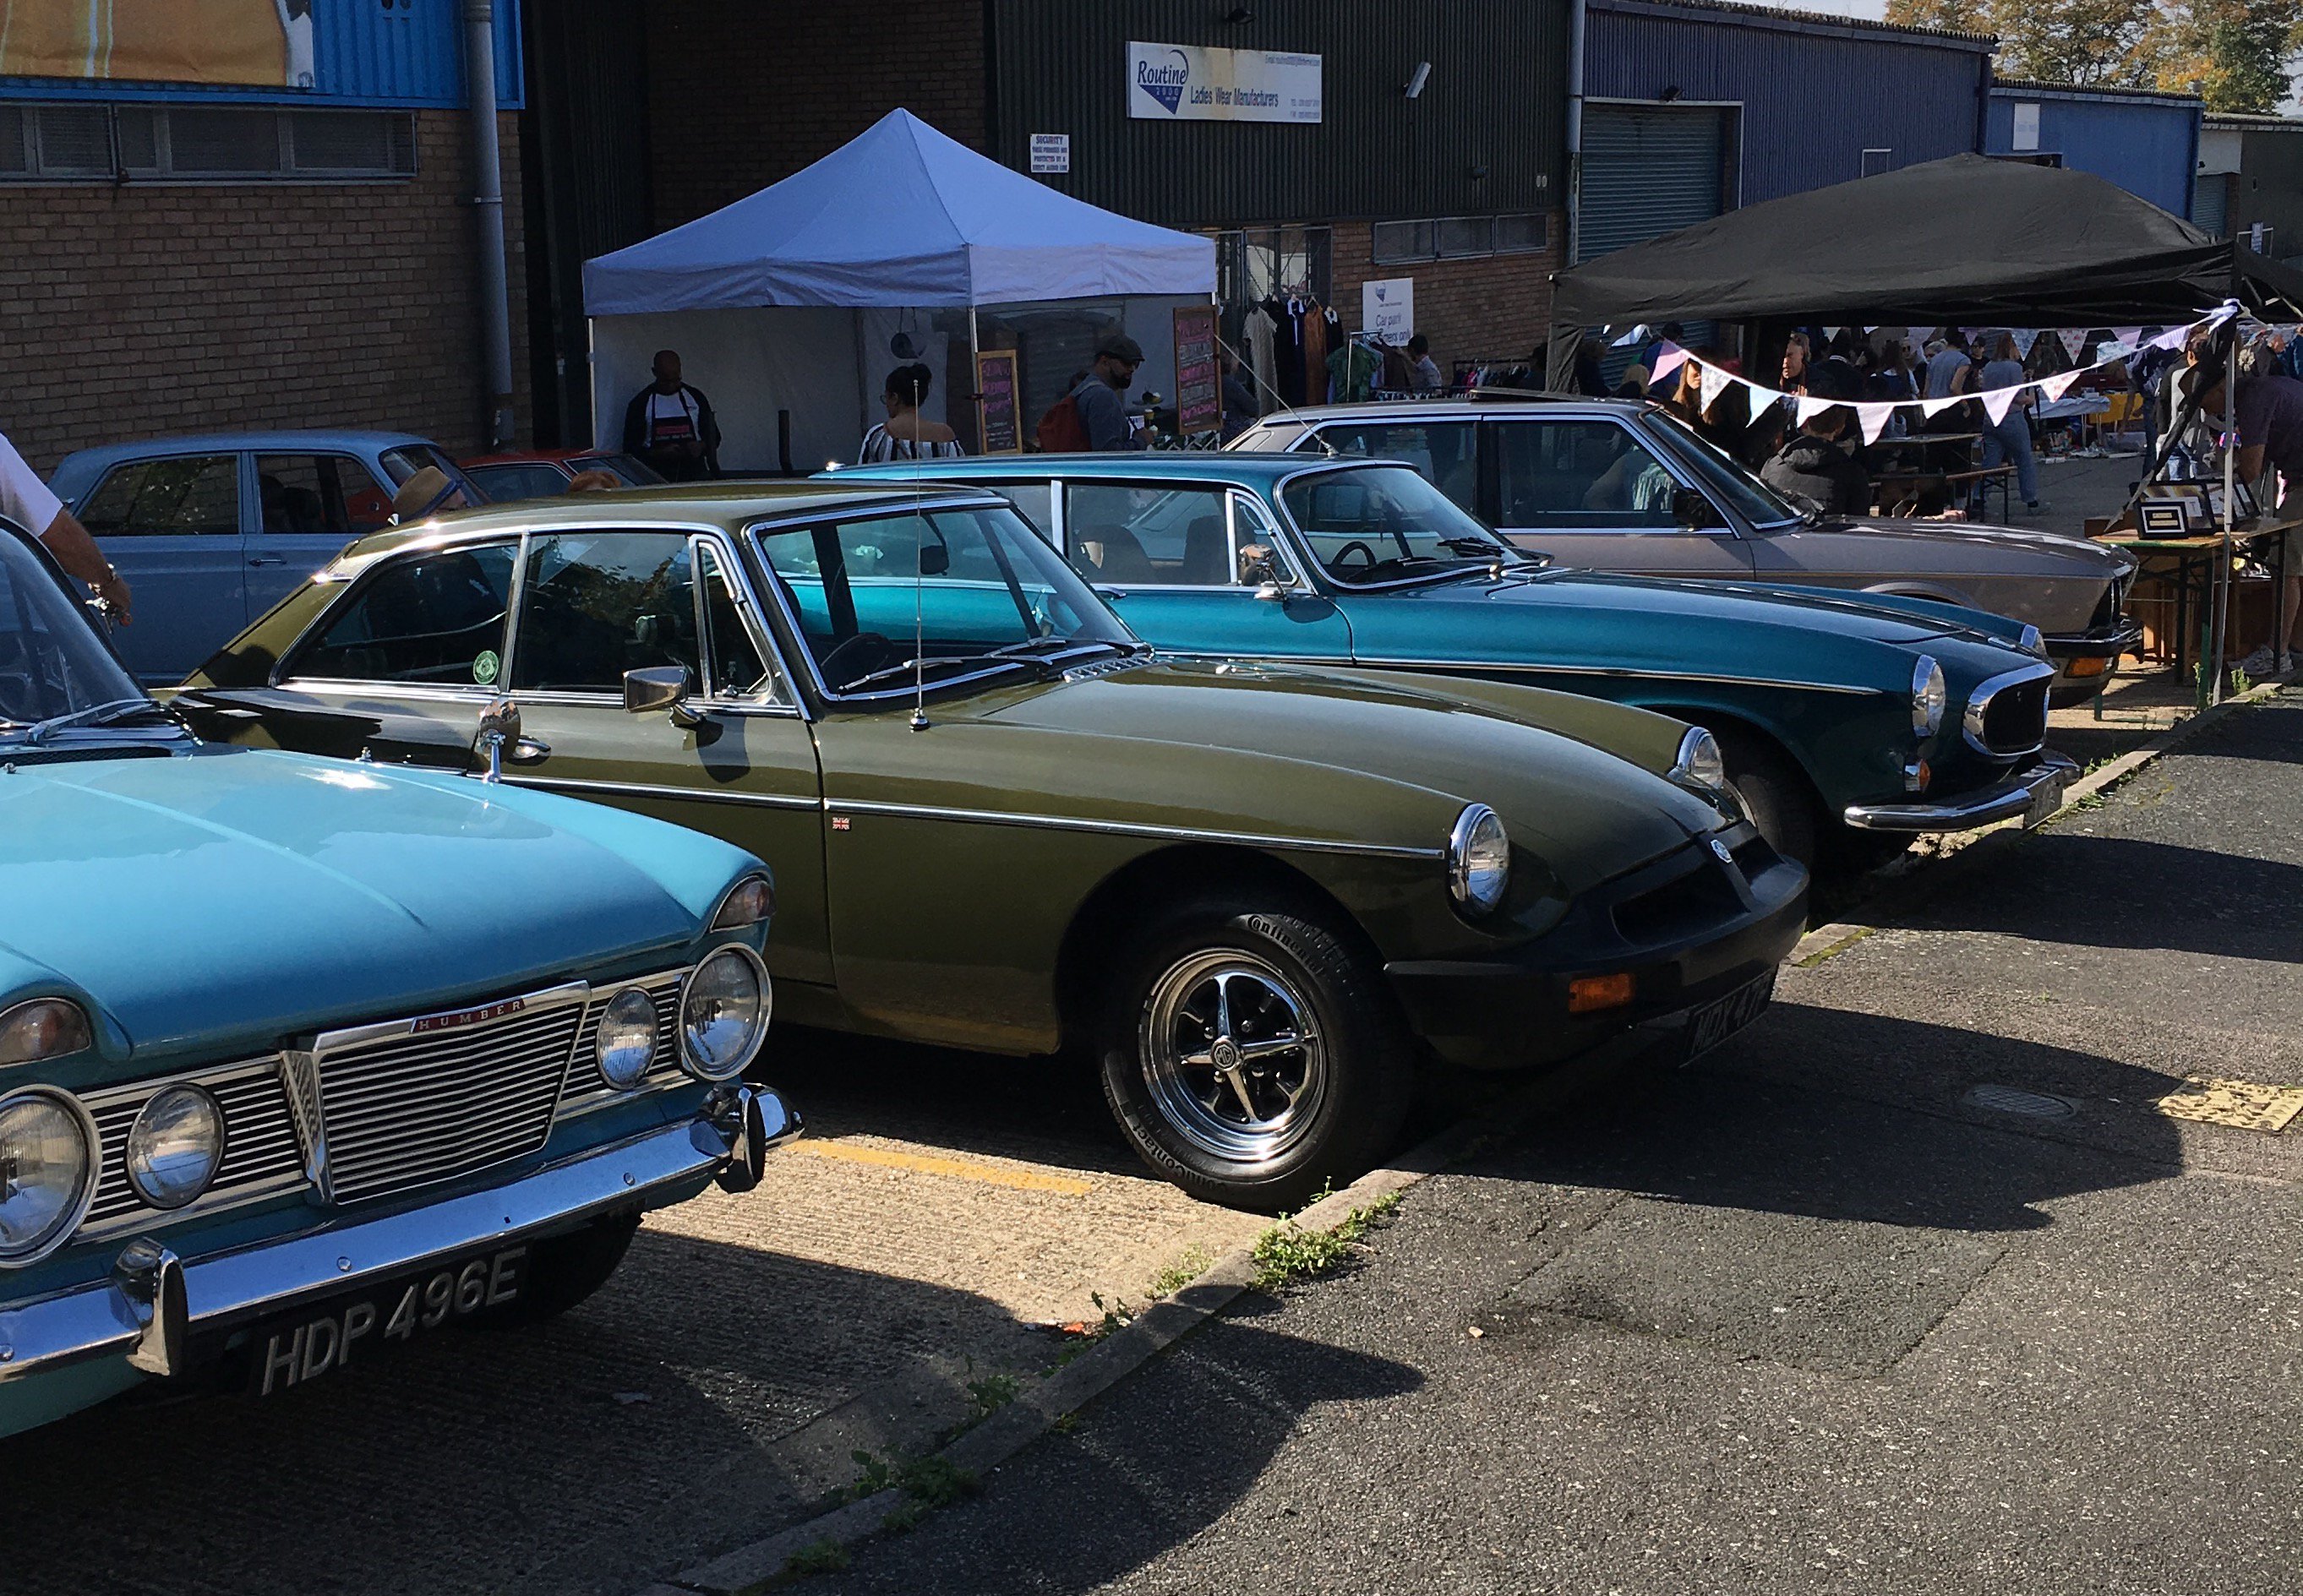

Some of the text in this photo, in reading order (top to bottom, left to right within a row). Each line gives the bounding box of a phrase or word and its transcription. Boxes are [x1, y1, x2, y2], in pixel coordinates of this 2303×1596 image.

[1138, 60, 1187, 84] Routine
[1156, 87, 1180, 95] 2000
[1190, 85, 1213, 105] Ladies
[1215, 86, 1232, 106] Wear
[1234, 88, 1280, 107] Manufacturers
[1035, 136, 1063, 144] SECURITY
[1376, 314, 1387, 327] Car
[1247, 914, 1324, 975] Continental
[419, 1000, 521, 1030] HUMBER
[1216, 1047, 1232, 1064] MG
[261, 1246, 527, 1396] HDP 496E
